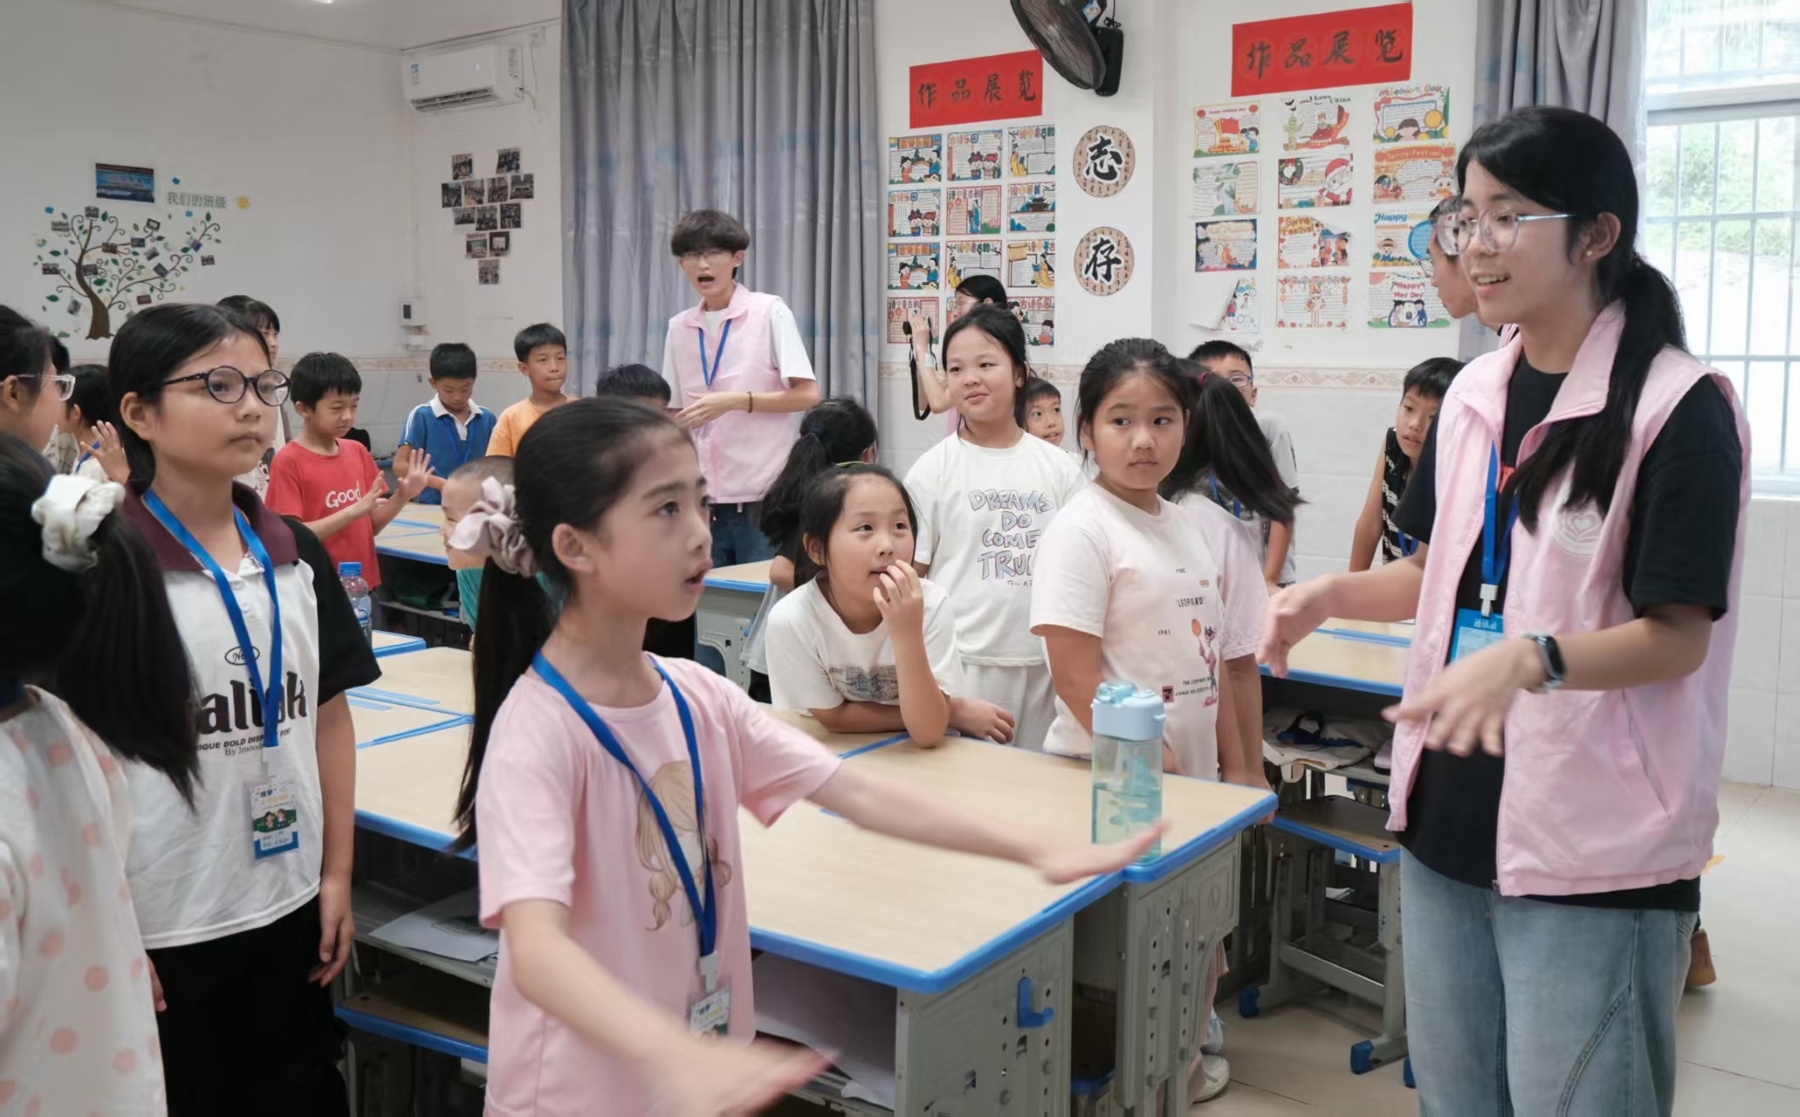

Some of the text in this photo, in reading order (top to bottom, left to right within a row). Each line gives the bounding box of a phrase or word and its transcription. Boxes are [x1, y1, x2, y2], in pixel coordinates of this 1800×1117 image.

[1247, 29, 1403, 80] 作品展览
[917, 69, 1037, 109] 作品展览
[1086, 135, 1123, 181] 志
[167, 191, 227, 209] 我们的班级
[1286, 216, 1311, 227] Spring
[1375, 213, 1407, 222] Happy
[1282, 225, 1314, 236] Festival
[1085, 236, 1122, 283] 存
[325, 480, 362, 509] Good
[967, 488, 1055, 514] DREAMS
[1001, 510, 1032, 532] DO
[981, 528, 1041, 549] COME
[223, 738, 247, 749] BOLD
[225, 748, 237, 757] By
